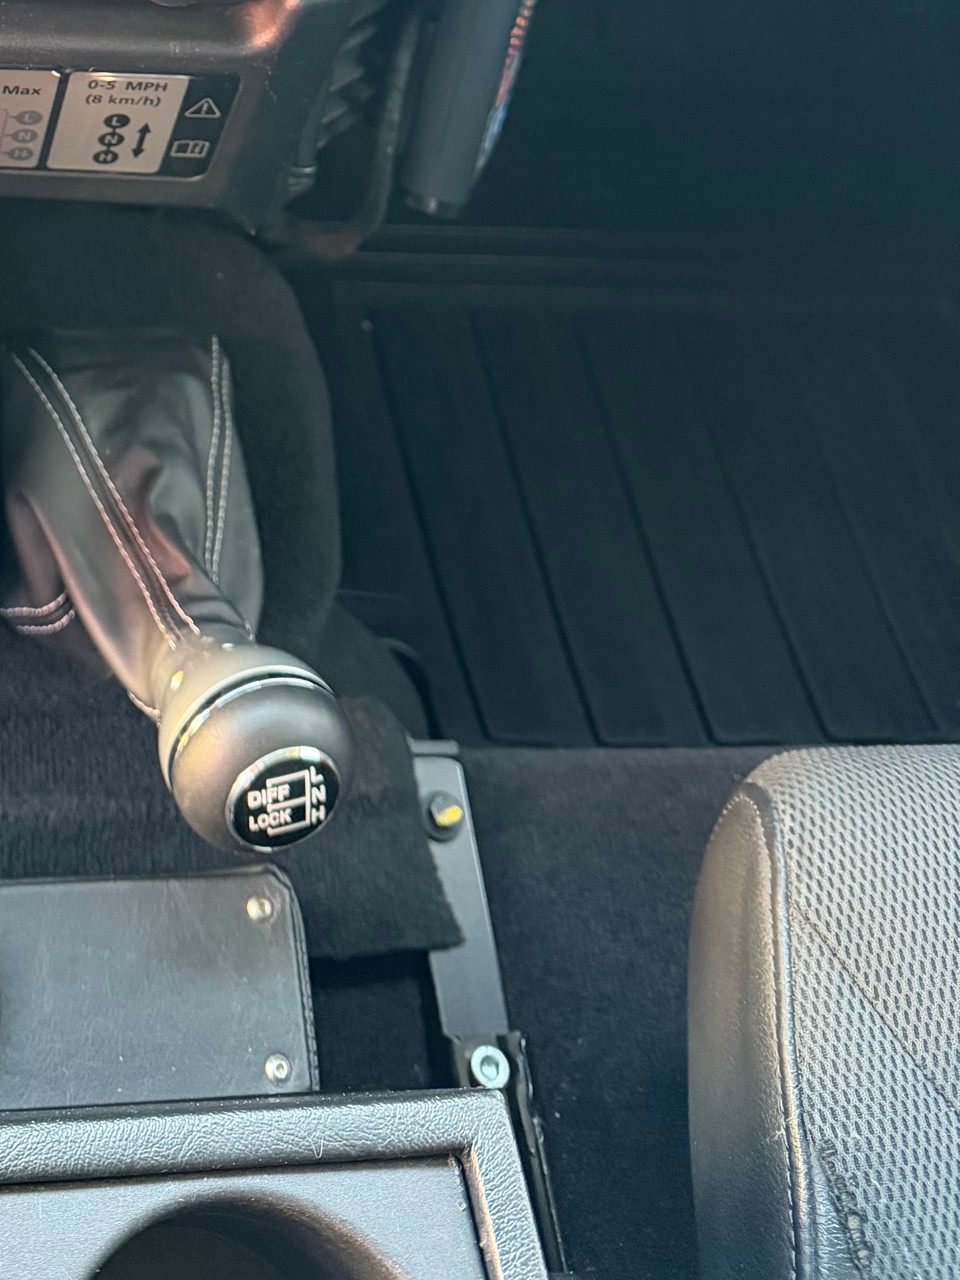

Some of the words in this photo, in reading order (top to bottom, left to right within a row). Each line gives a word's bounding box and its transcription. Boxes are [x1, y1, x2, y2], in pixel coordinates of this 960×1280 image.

[2, 84, 42, 97] Max
[87, 79, 117, 91] 0-5
[125, 80, 169, 92] MPH
[85, 93, 102, 107] (8
[104, 93, 162, 108] km/h)
[103, 134, 119, 144] N
[309, 765, 325, 785] L
[246, 783, 290, 811] DIFF
[311, 784, 327, 806] N
[248, 807, 293, 833] LOCK
[311, 805, 326, 826] H
